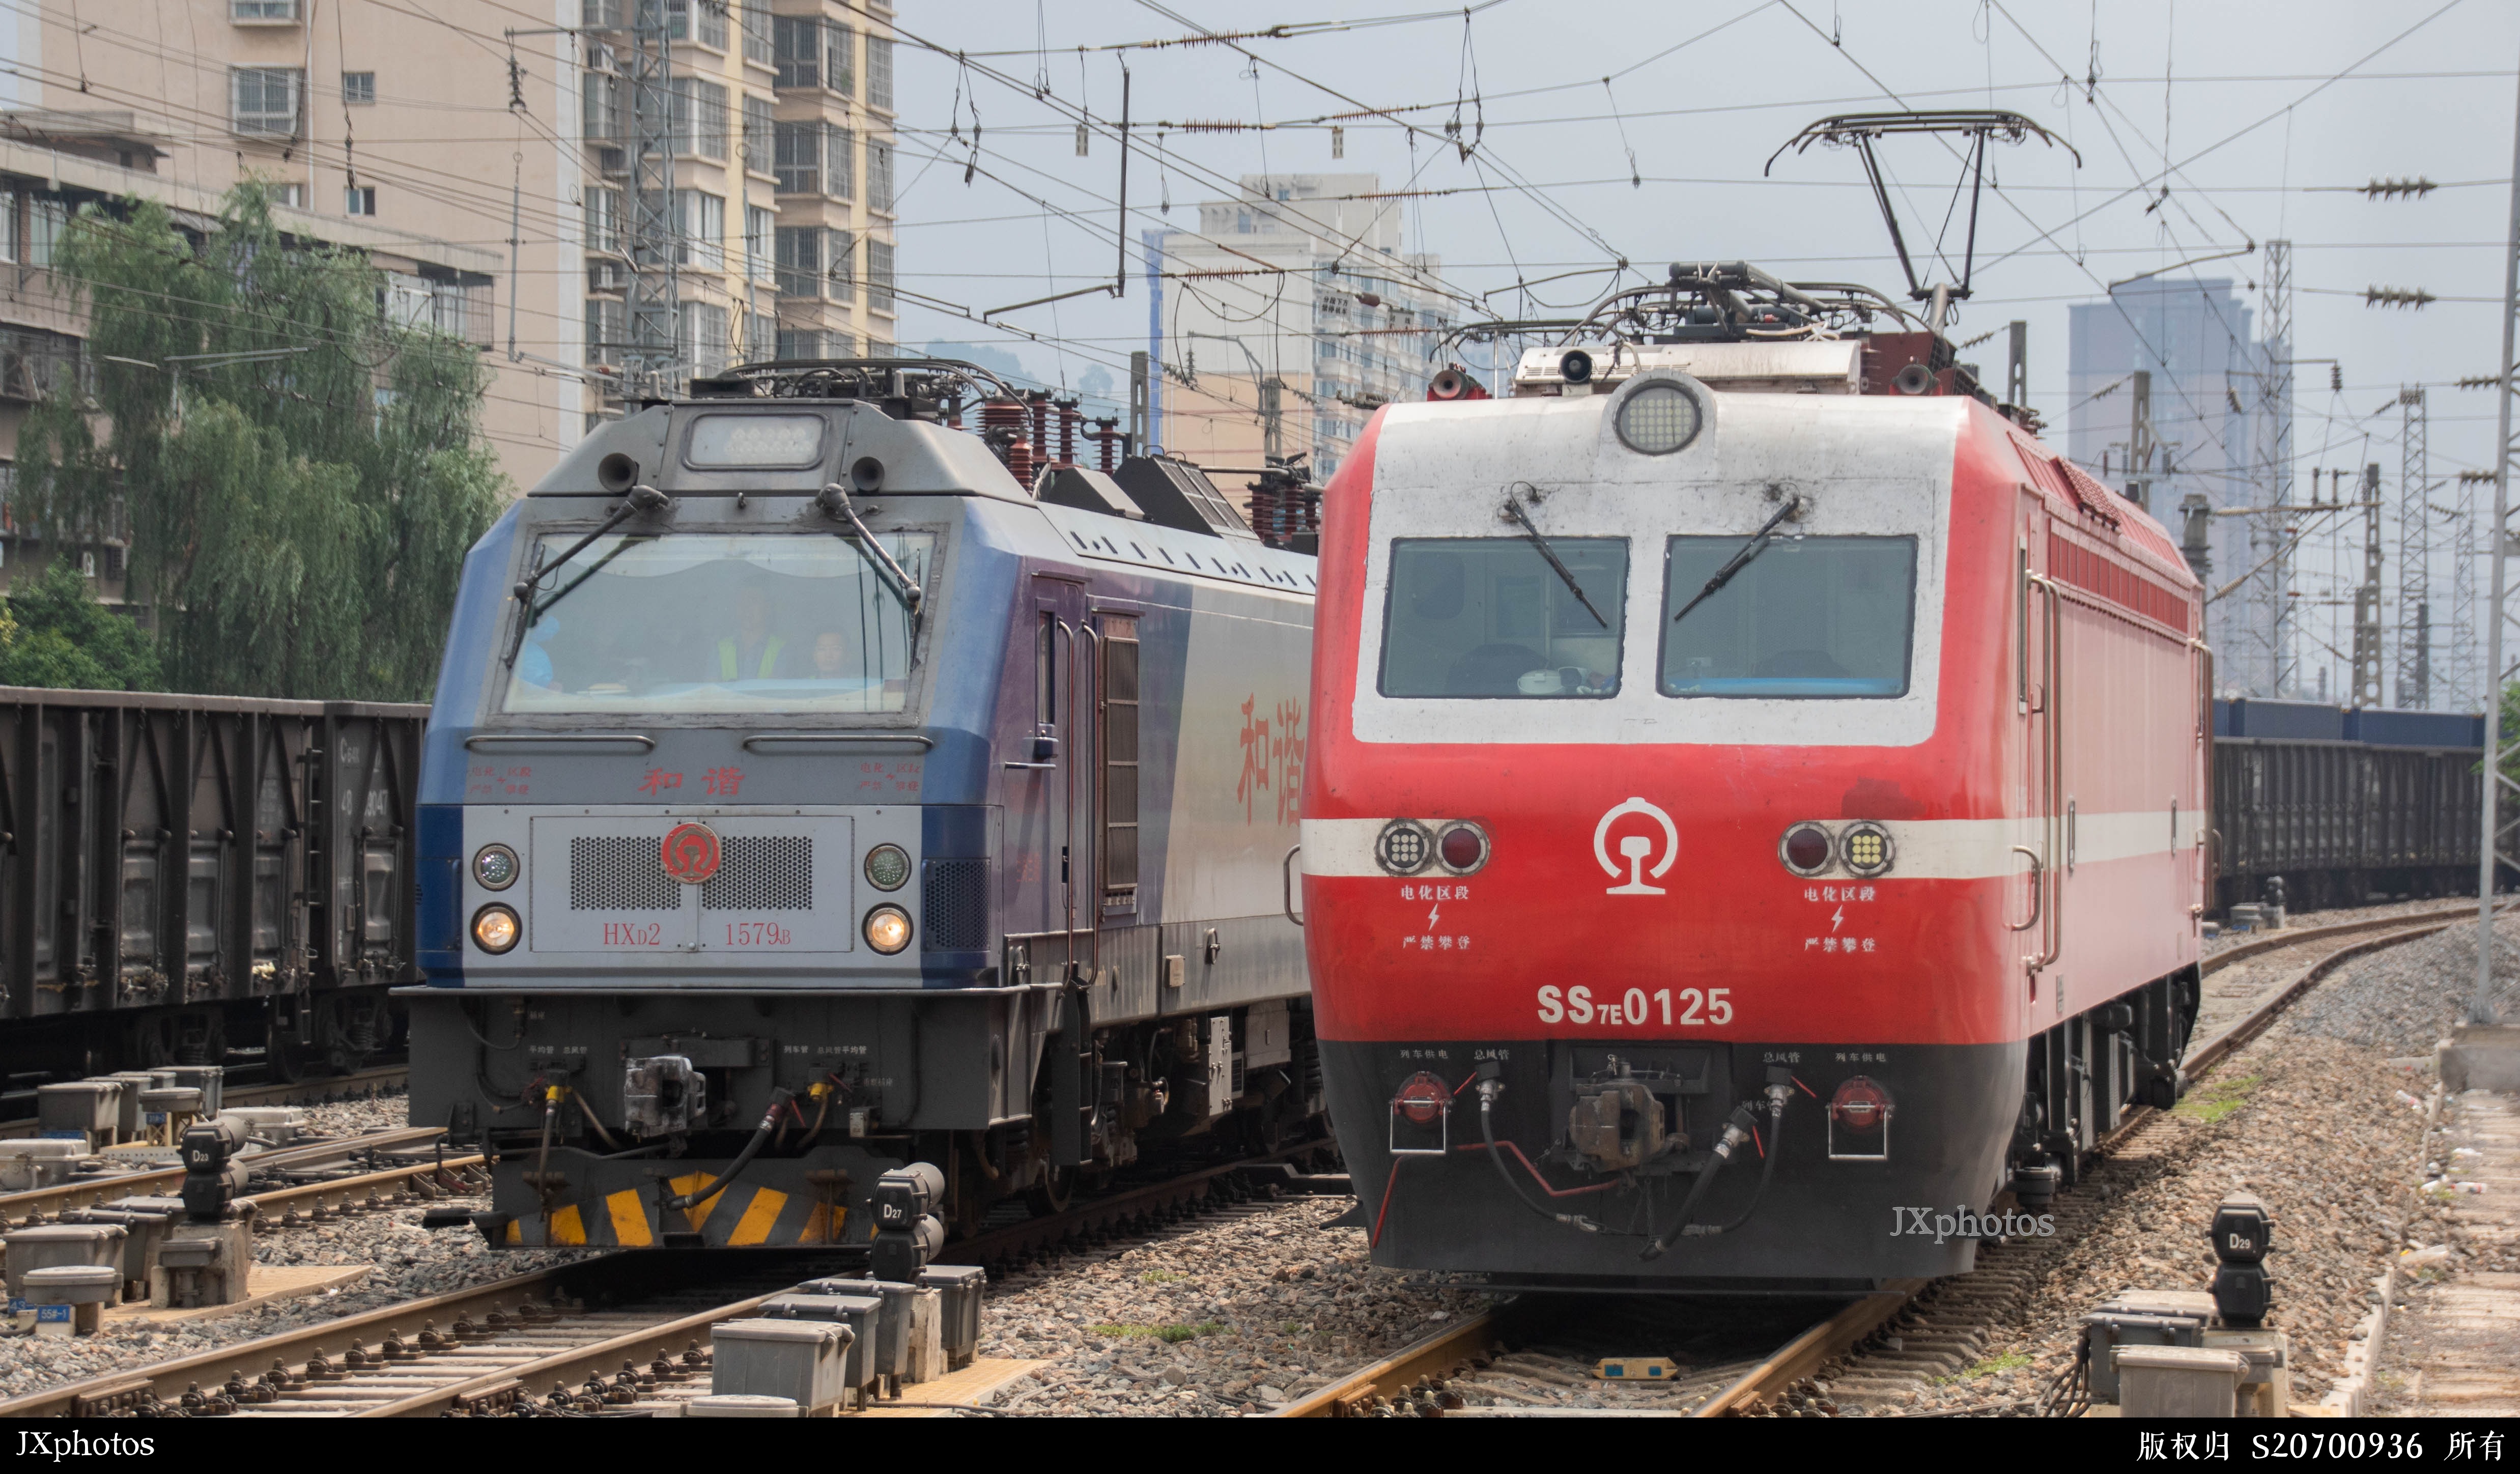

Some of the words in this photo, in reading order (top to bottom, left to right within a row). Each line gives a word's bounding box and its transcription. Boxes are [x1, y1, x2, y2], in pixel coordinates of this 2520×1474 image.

[1237, 692, 1305, 828] 和谐
[637, 767, 746, 796] 和谐
[1401, 885, 1469, 900] 电化区段
[1804, 886, 1876, 901] 电化区段
[603, 922, 660, 945] HXD2
[1403, 935, 1470, 950] 严禁攀登
[1804, 937, 1876, 952] 严禁攀登
[1400, 1050, 1448, 1059] 列车供电
[1474, 1050, 1509, 1060] 总风管
[1763, 1052, 1800, 1063] 总风管
[1835, 1052, 1886, 1062] 列车供电
[193, 1150, 209, 1162] D23
[884, 1204, 902, 1218] D27
[2229, 1233, 2250, 1249] D29
[41, 1309, 67, 1319] 55#-1
